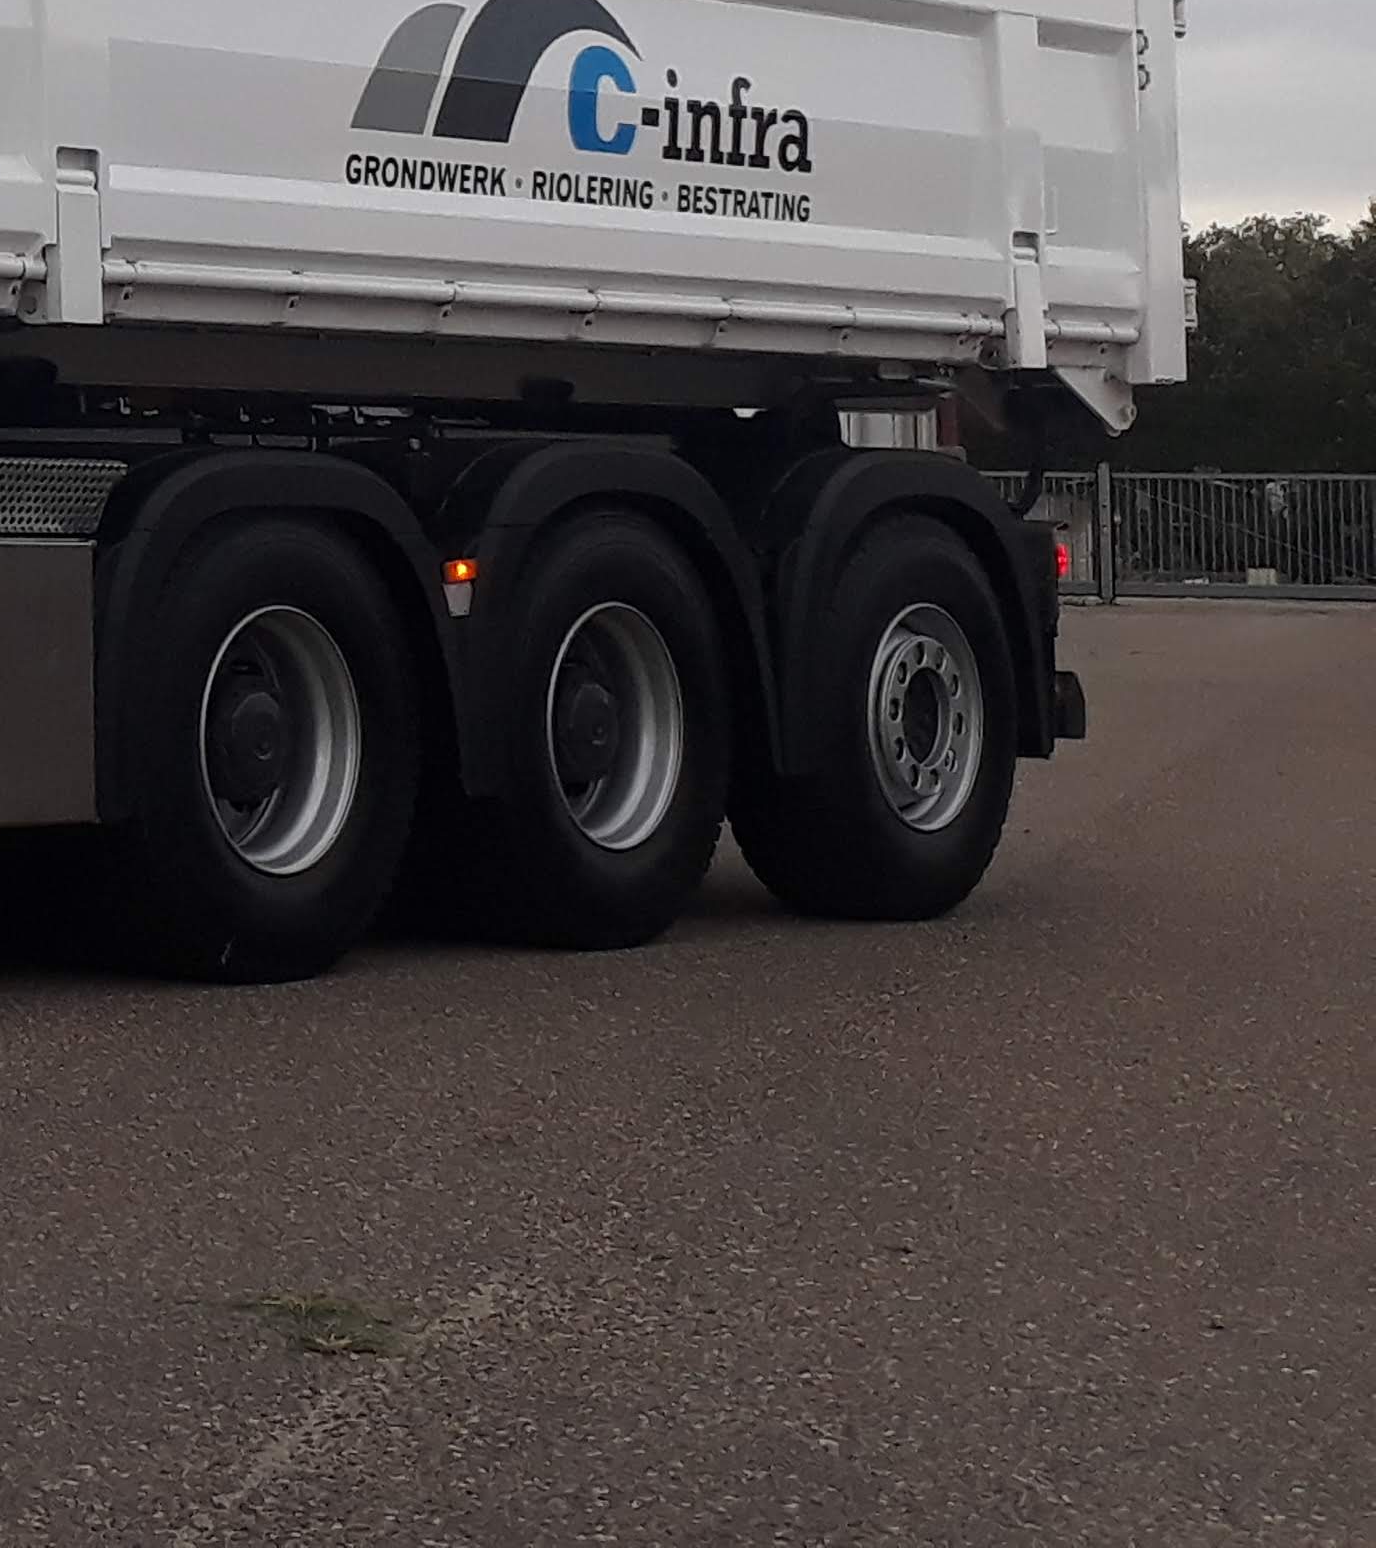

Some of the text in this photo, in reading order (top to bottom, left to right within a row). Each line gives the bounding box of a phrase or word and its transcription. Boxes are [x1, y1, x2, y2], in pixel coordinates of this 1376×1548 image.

[568, 45, 813, 174] C-infra
[345, 153, 812, 222] GRONDWERK RIOLERING BESTRATING
